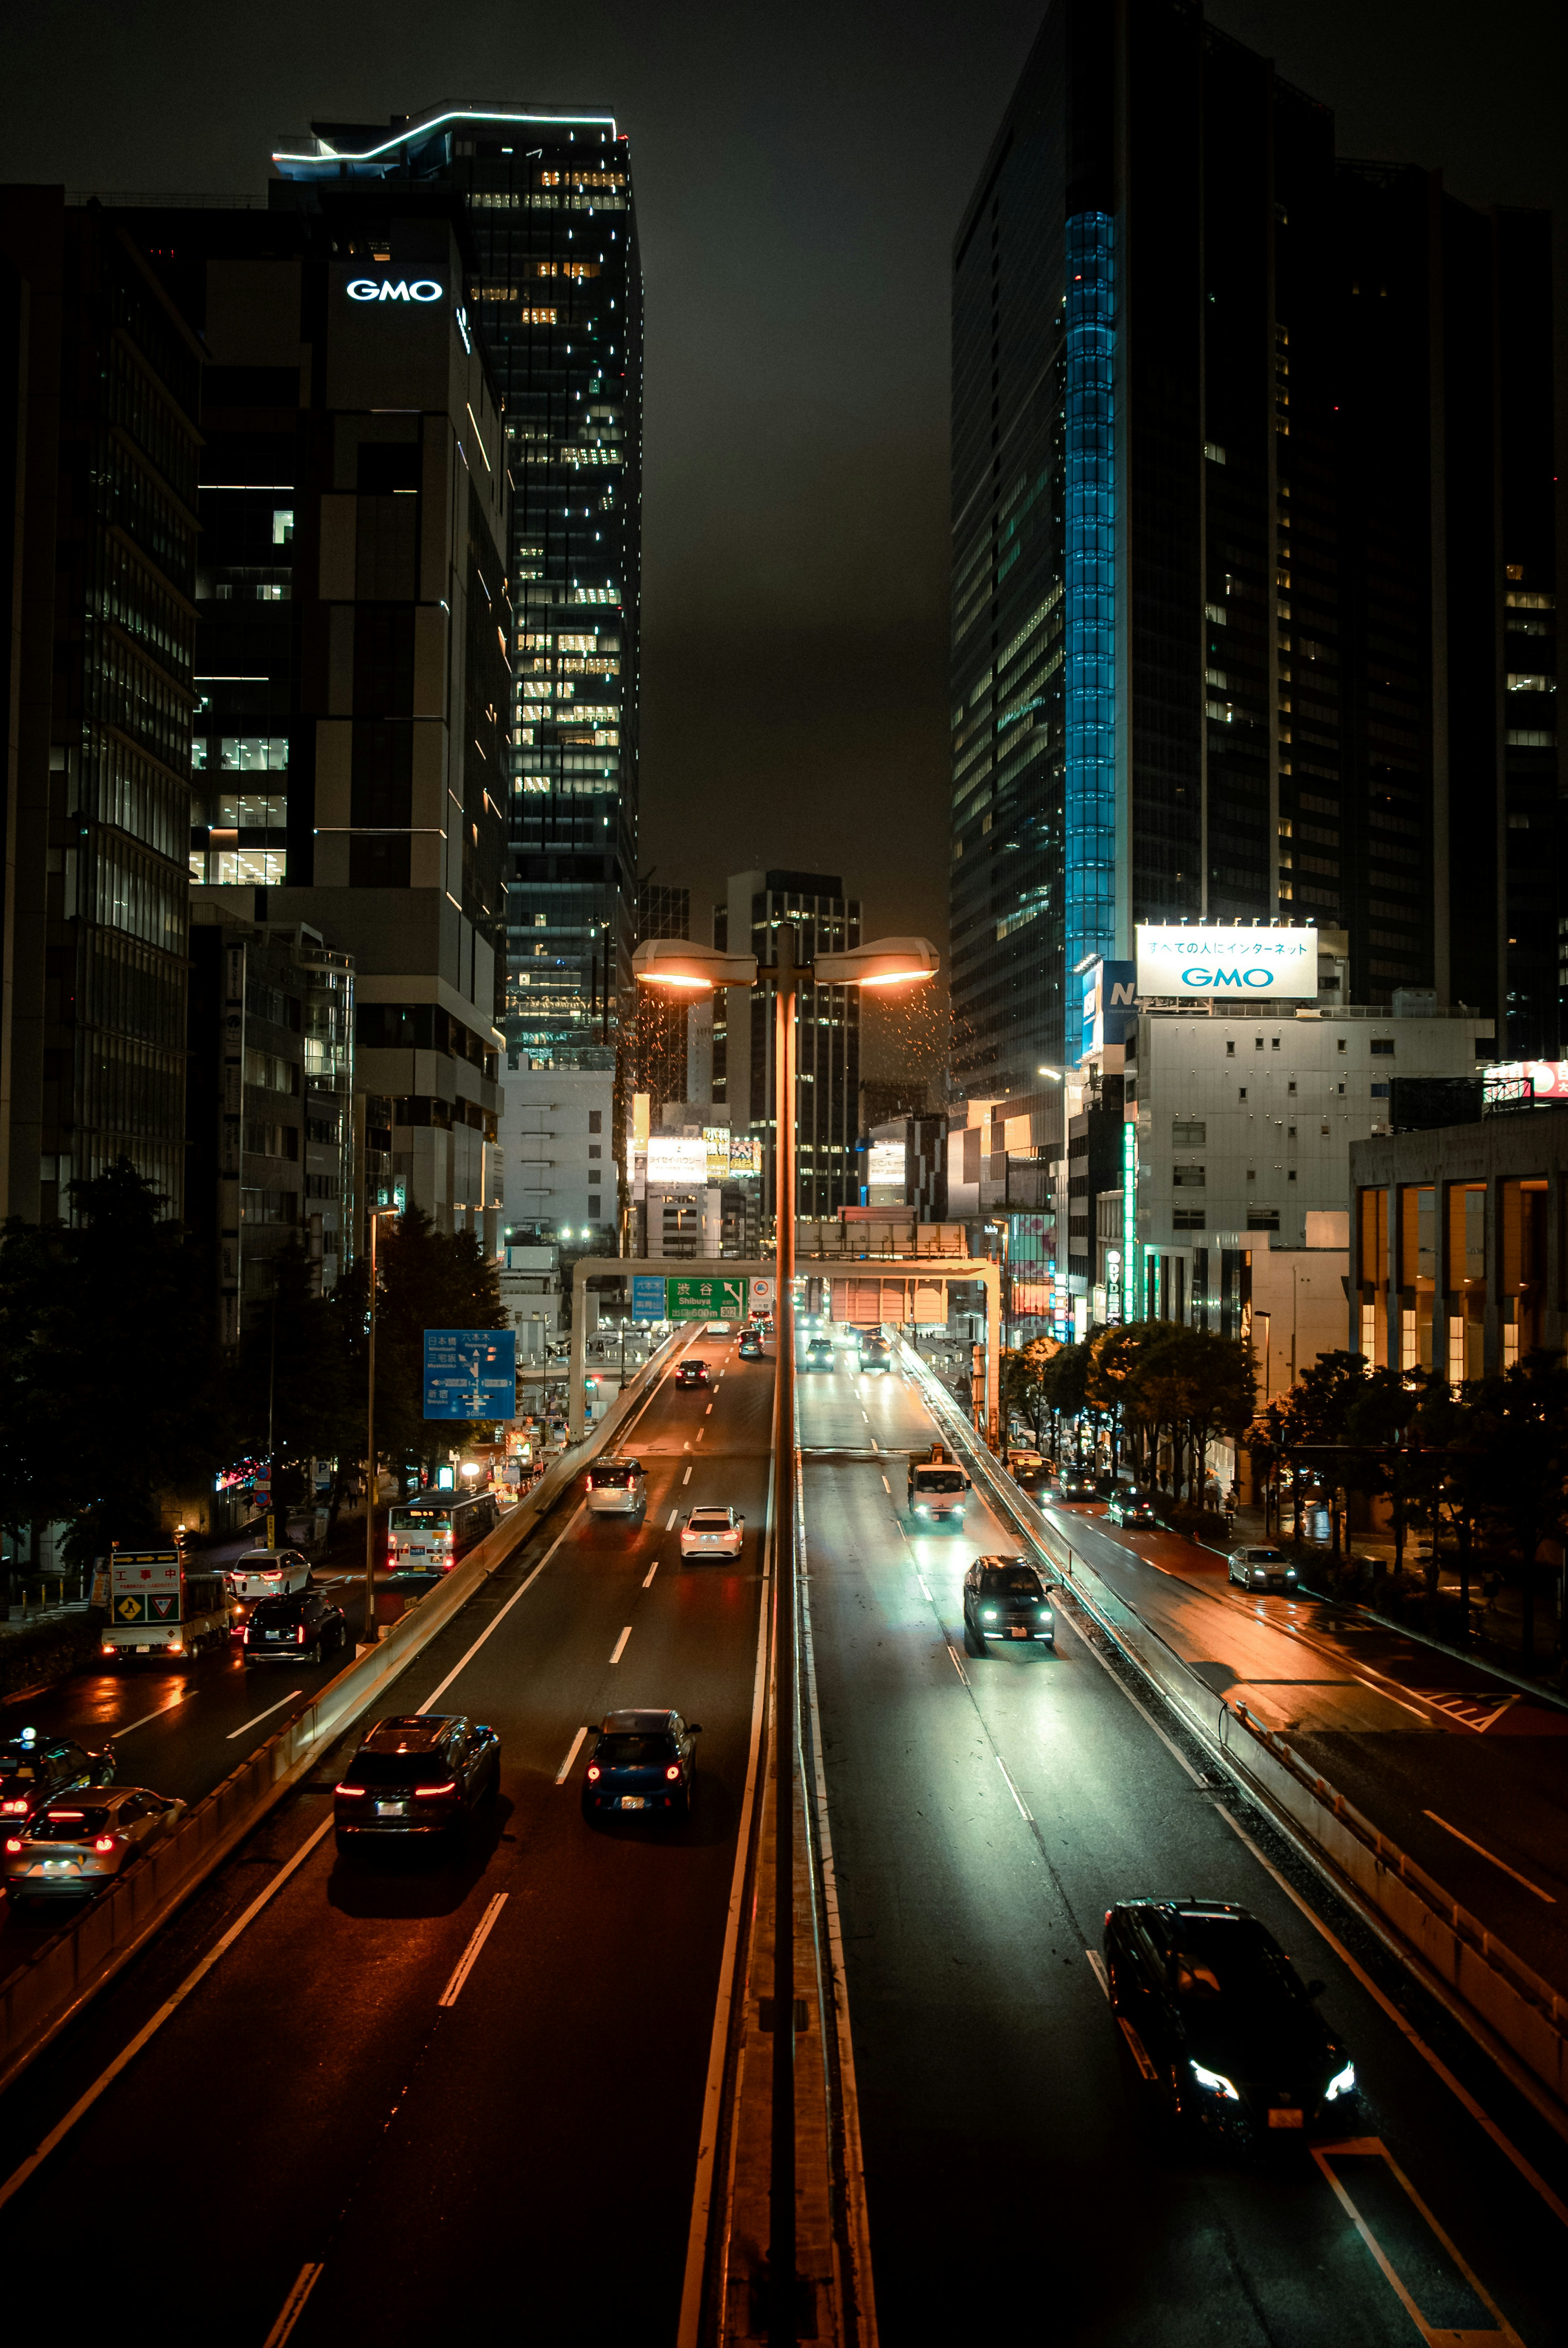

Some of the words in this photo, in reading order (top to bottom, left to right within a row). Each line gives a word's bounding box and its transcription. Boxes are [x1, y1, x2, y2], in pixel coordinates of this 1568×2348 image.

[346, 280, 443, 301] GMO
[1148, 942, 1307, 955] すべての人にインターネット
[1181, 968, 1274, 987] GMO
[677, 1283, 713, 1296] 渋谷
[679, 1297, 711, 1306] Shibuya
[672, 1309, 688, 1317] 出口
[691, 1309, 717, 1317] 600m
[722, 1308, 735, 1316] 302
[428, 1336, 457, 1346] 日本橋
[461, 1333, 491, 1342] 六本木
[428, 1354, 457, 1362] 三宅坂
[319, 1463, 327, 1474] P
[115, 1568, 176, 1581] 工事中
